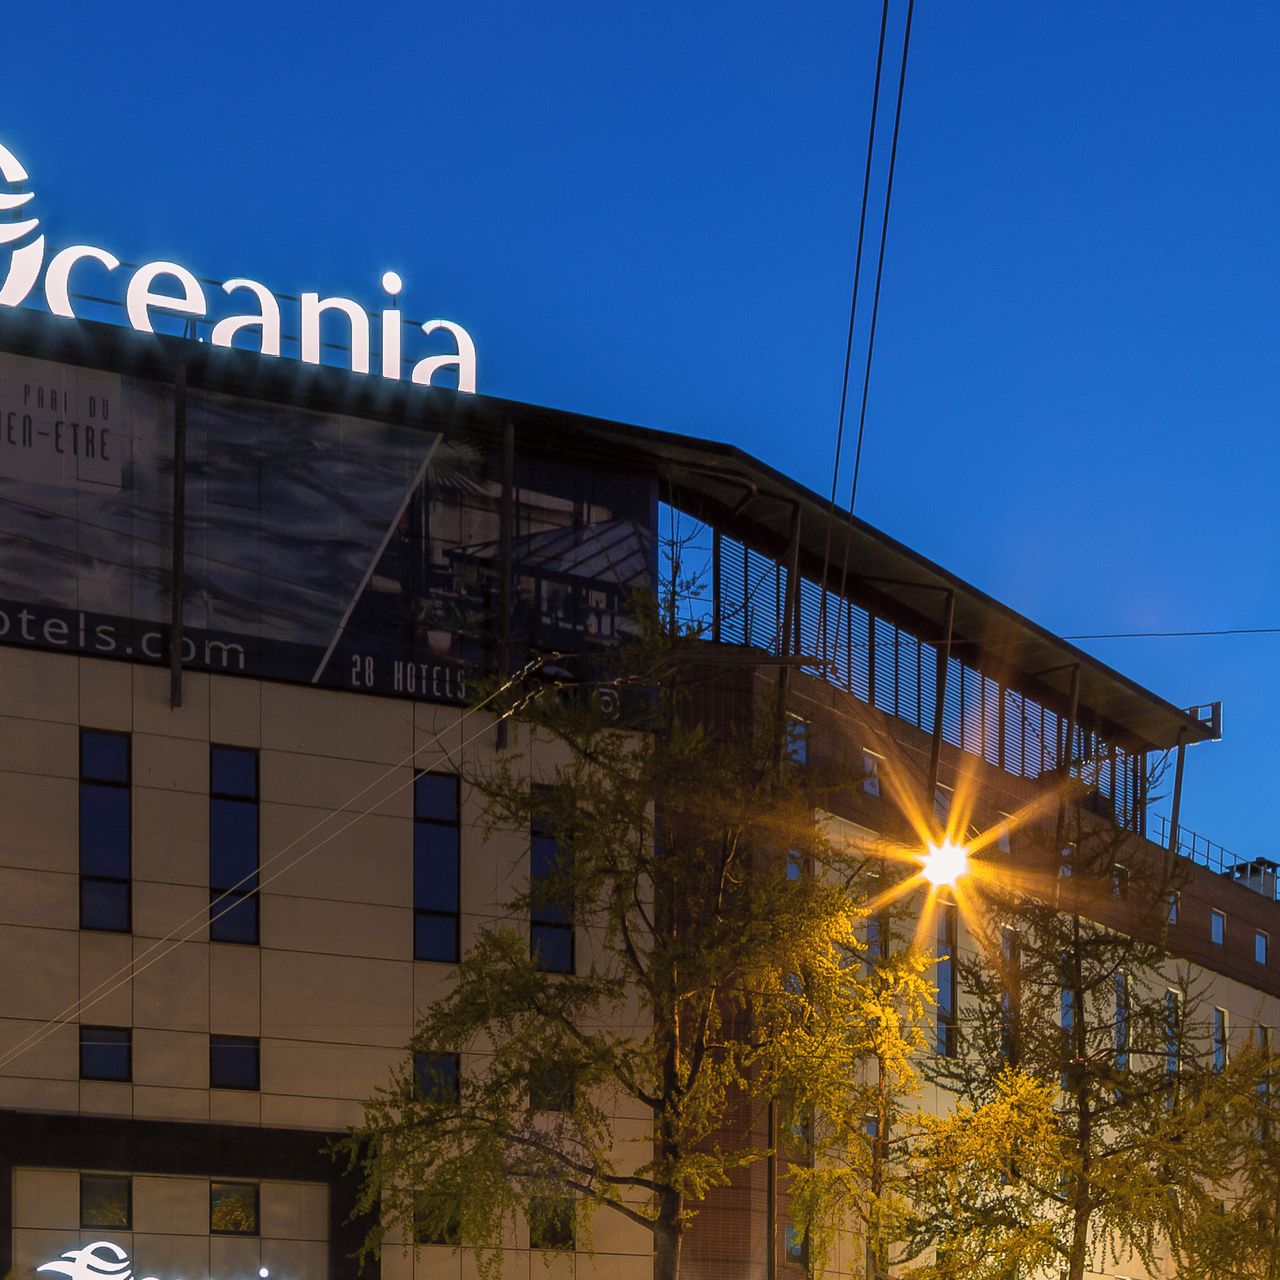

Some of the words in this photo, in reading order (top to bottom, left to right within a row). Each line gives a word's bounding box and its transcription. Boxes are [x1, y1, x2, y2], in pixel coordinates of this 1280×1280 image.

[23, 384, 68, 414] PARI
[89, 395, 110, 421] DU
[351, 654, 374, 687] 28
[393, 660, 466, 699] HOTELS
